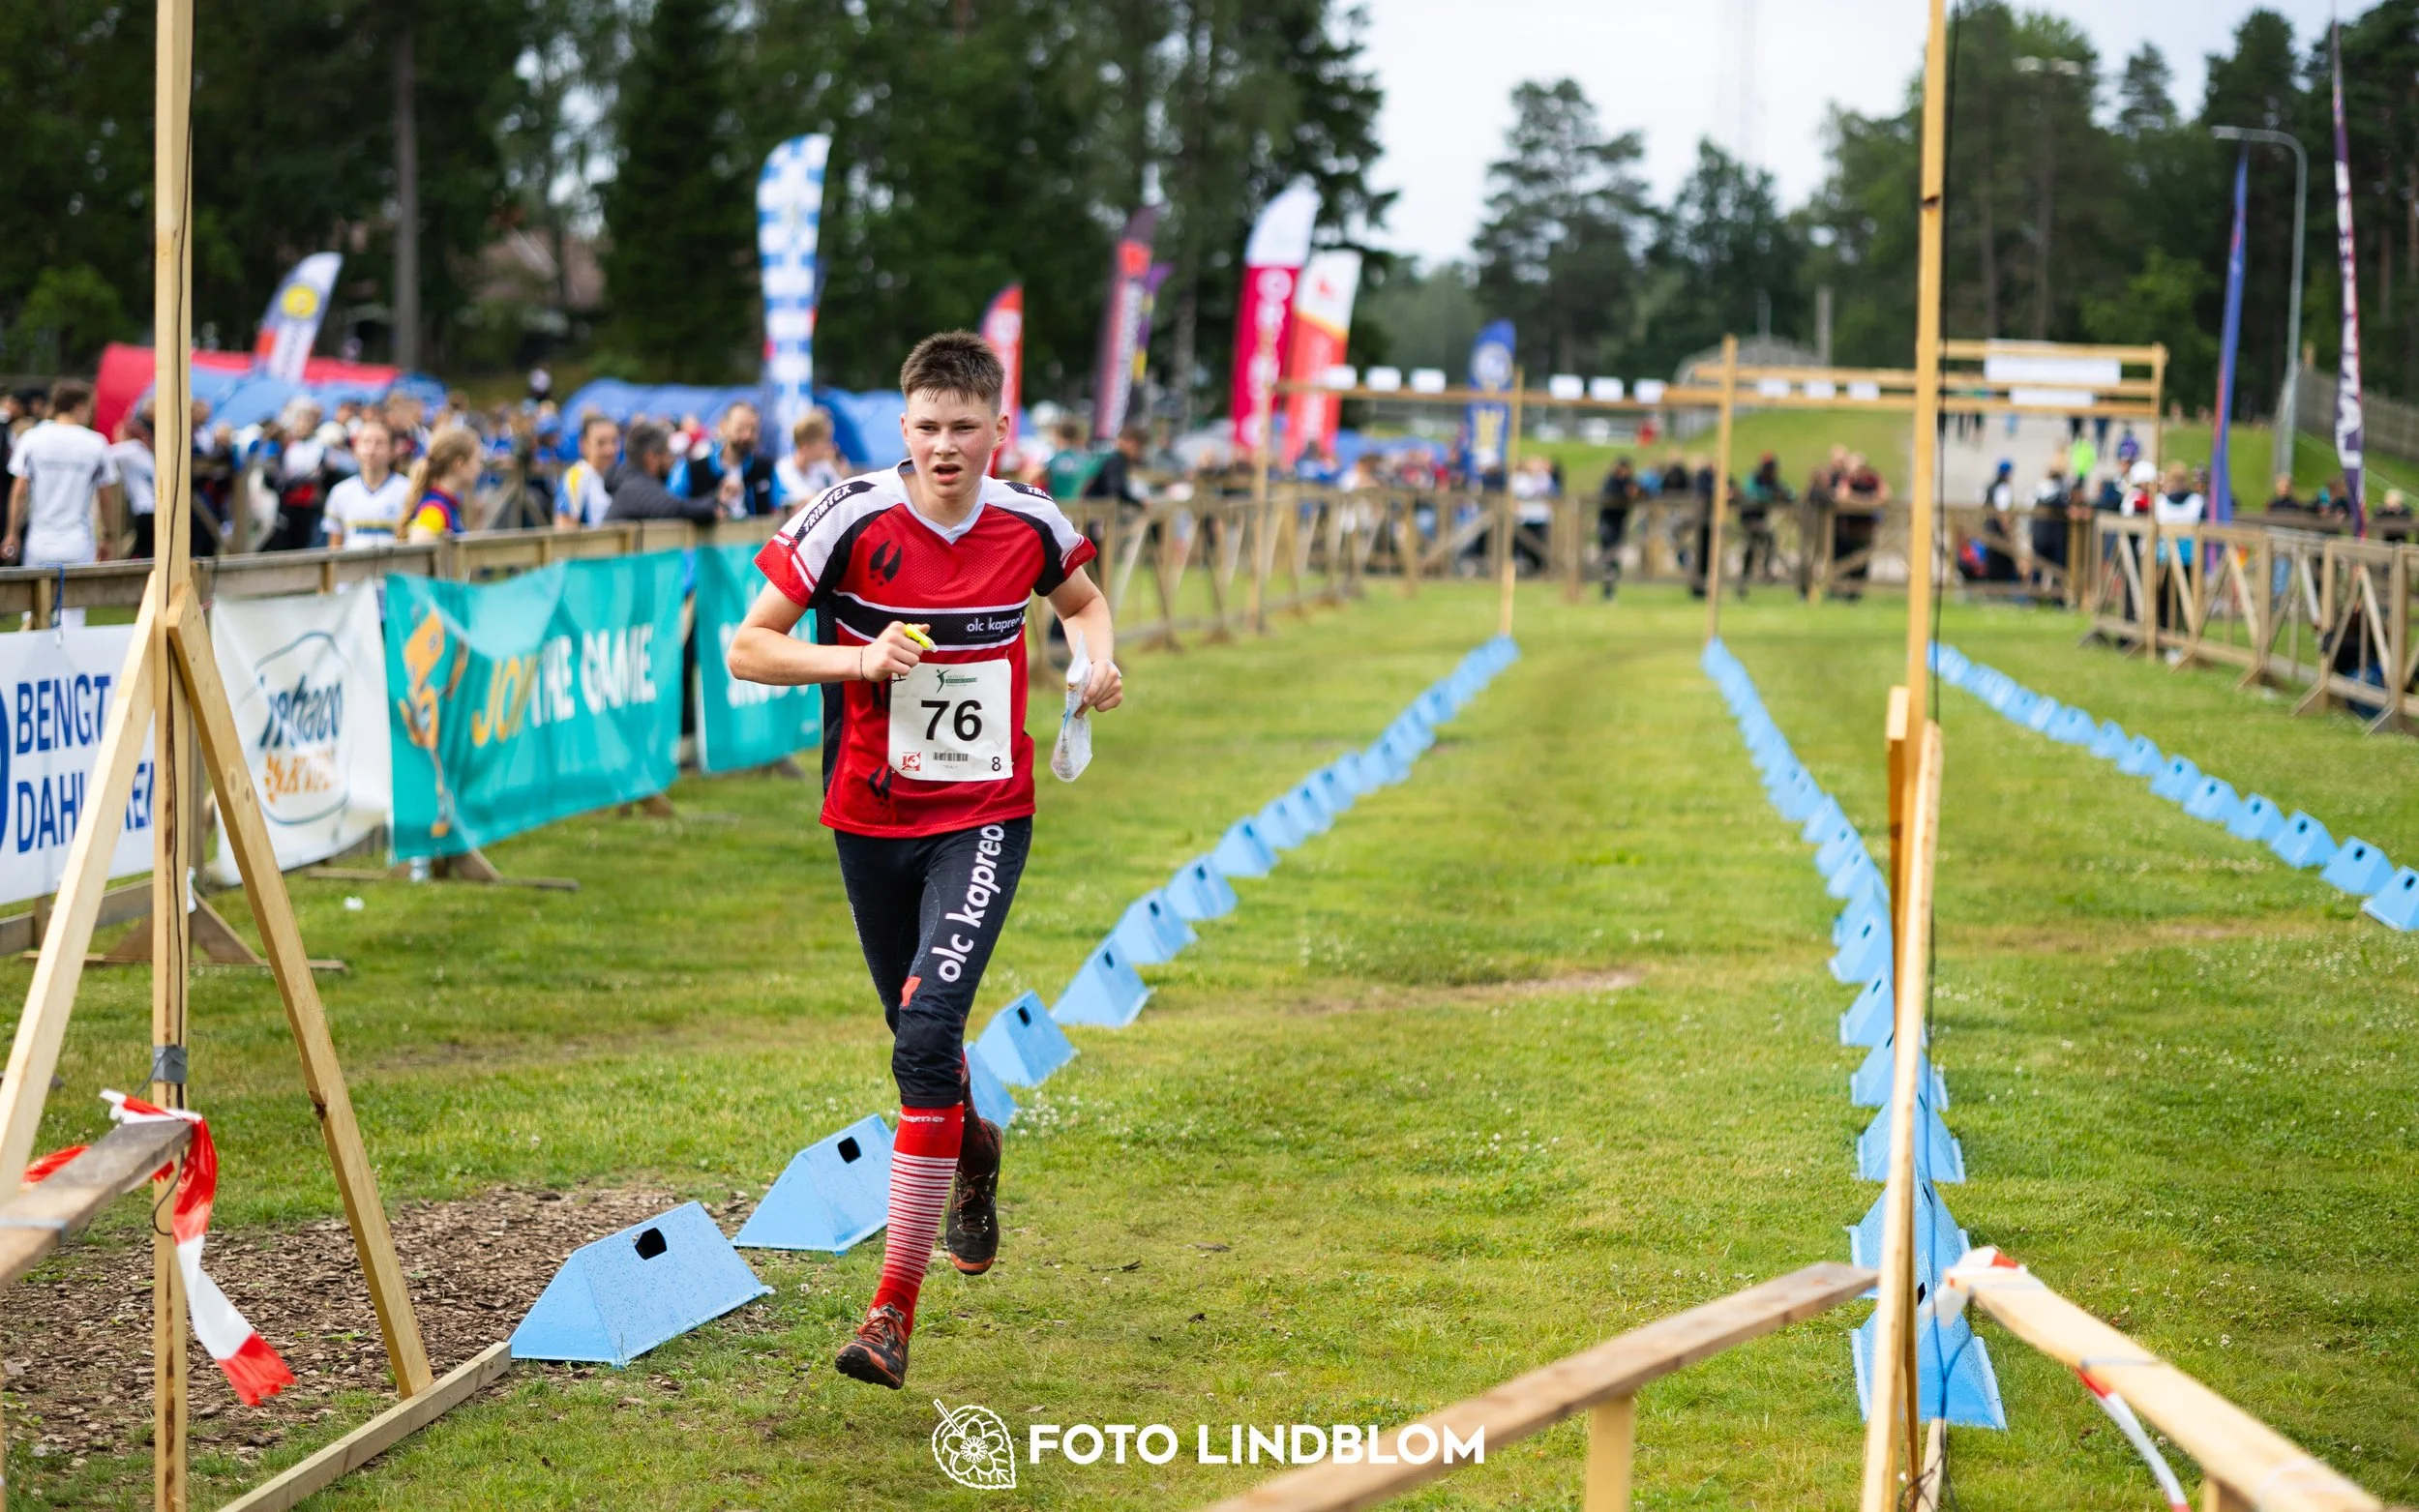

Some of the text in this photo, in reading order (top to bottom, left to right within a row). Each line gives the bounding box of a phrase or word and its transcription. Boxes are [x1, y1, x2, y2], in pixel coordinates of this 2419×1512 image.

[802, 484, 851, 532] TRIMTEX
[967, 617, 985, 632] olc
[15, 674, 111, 756] BENGT
[921, 699, 982, 742] 76
[991, 756, 1001, 772] 8
[931, 821, 1005, 984] olc kapreo
